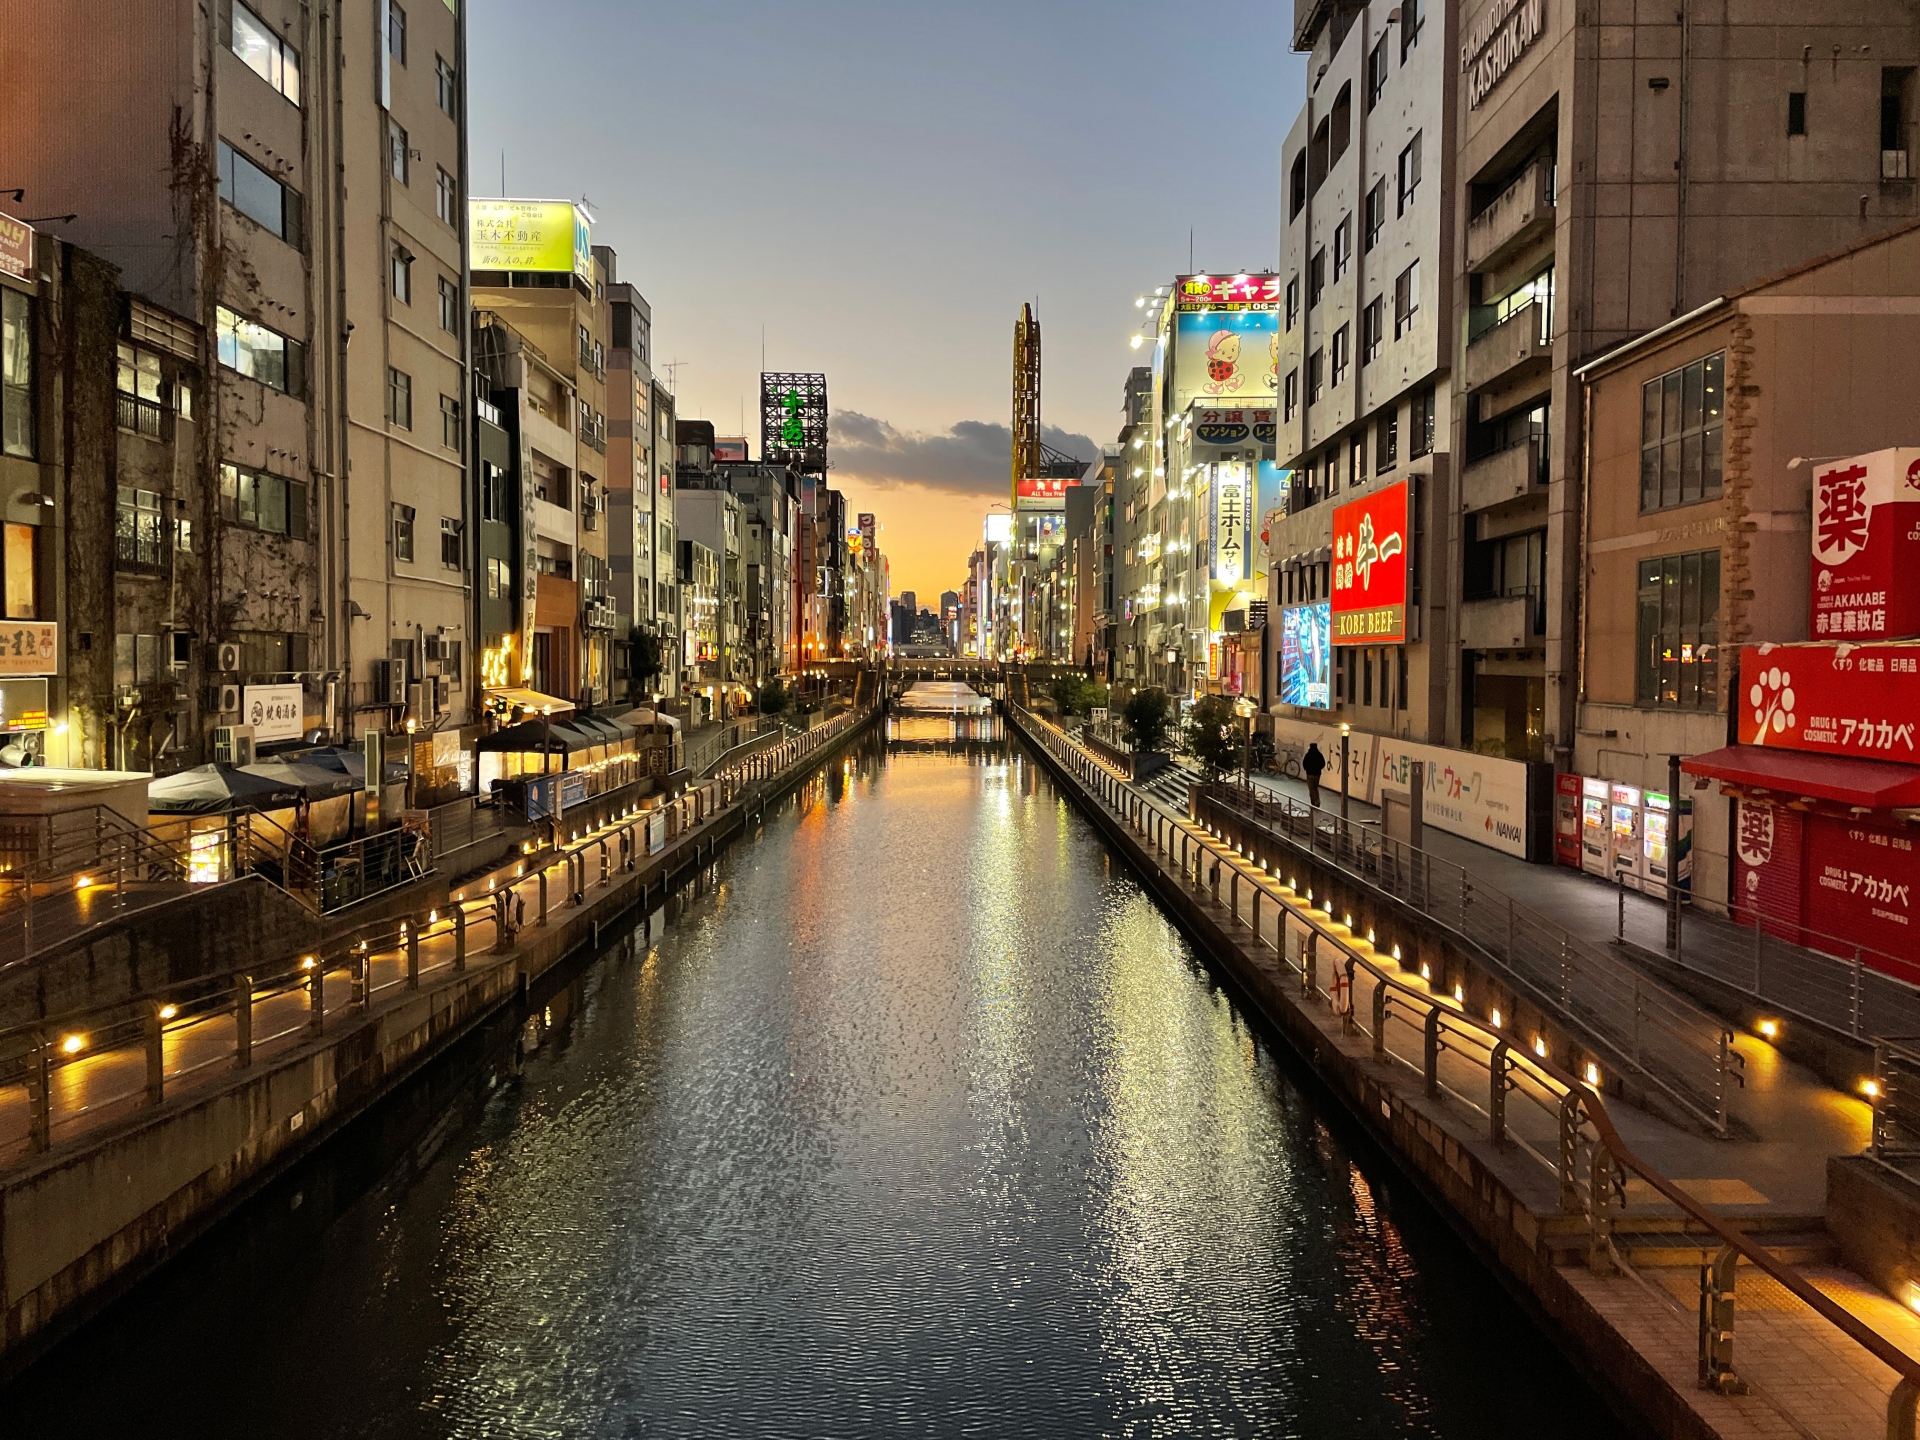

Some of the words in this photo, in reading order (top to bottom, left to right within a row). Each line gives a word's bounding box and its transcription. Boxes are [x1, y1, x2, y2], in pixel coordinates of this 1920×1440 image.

[1469, 0, 1541, 112] KASHOKAN
[476, 219, 514, 228] 株式会社
[476, 230, 542, 242] 玉木不動産
[1200, 426, 1247, 438] マンション
[1818, 464, 1868, 554] 薬
[1356, 512, 1402, 591] 牛一
[1834, 591, 1886, 608] AKAKABE
[1340, 613, 1365, 635] KOBE
[1367, 610, 1394, 634] BEEF
[1832, 658, 1853, 671] くすり
[1859, 657, 1884, 672] 化粧品
[1890, 658, 1917, 673] 日用品
[1810, 716, 1830, 729] DRUG
[1831, 717, 1837, 730] &
[1803, 729, 1838, 744] COSMETIC
[1840, 718, 1915, 751] アカカベ
[1426, 800, 1463, 822] RIVERWALK
[1495, 821, 1522, 843] NANKAI
[1848, 829, 1865, 841] くすり
[1868, 833, 1888, 846] 化粧品
[1892, 837, 1912, 851] 日用品
[1825, 865, 1841, 878] DRUG
[1819, 875, 1848, 892] COSMETIC
[1849, 871, 1910, 907] アカカベ
